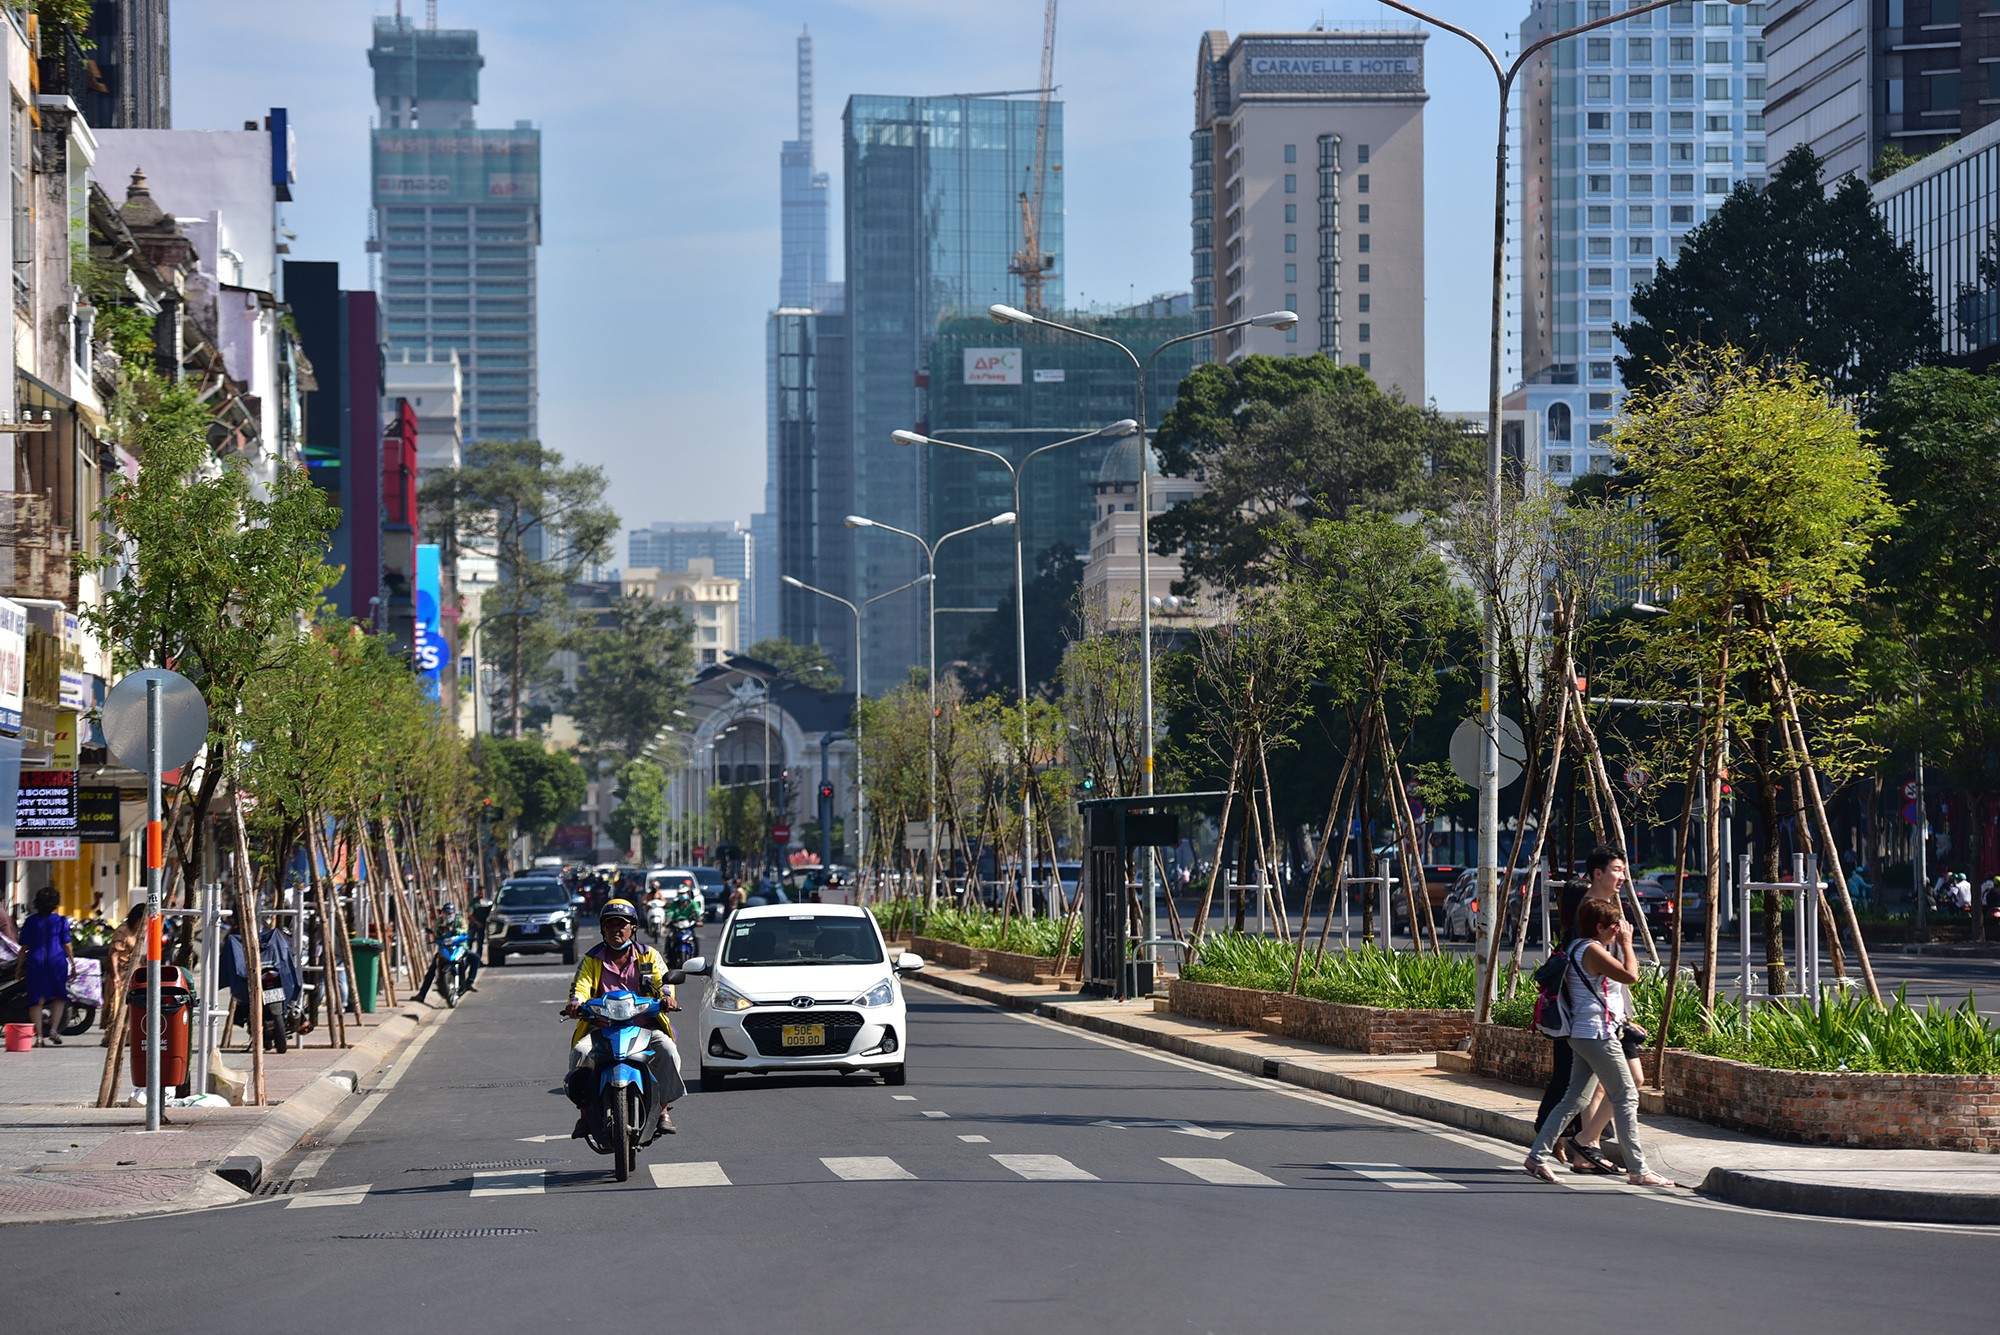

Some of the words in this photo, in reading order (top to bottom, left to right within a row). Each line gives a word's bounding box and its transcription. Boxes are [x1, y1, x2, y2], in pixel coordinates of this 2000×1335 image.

[1256, 60, 1353, 73] CARAVELLE
[1360, 60, 1414, 73] HOTEL
[36, 798, 69, 806] TOURS
[15, 840, 41, 857] CARD
[794, 1025, 812, 1036] 50E
[787, 1036, 820, 1045] 009.80
